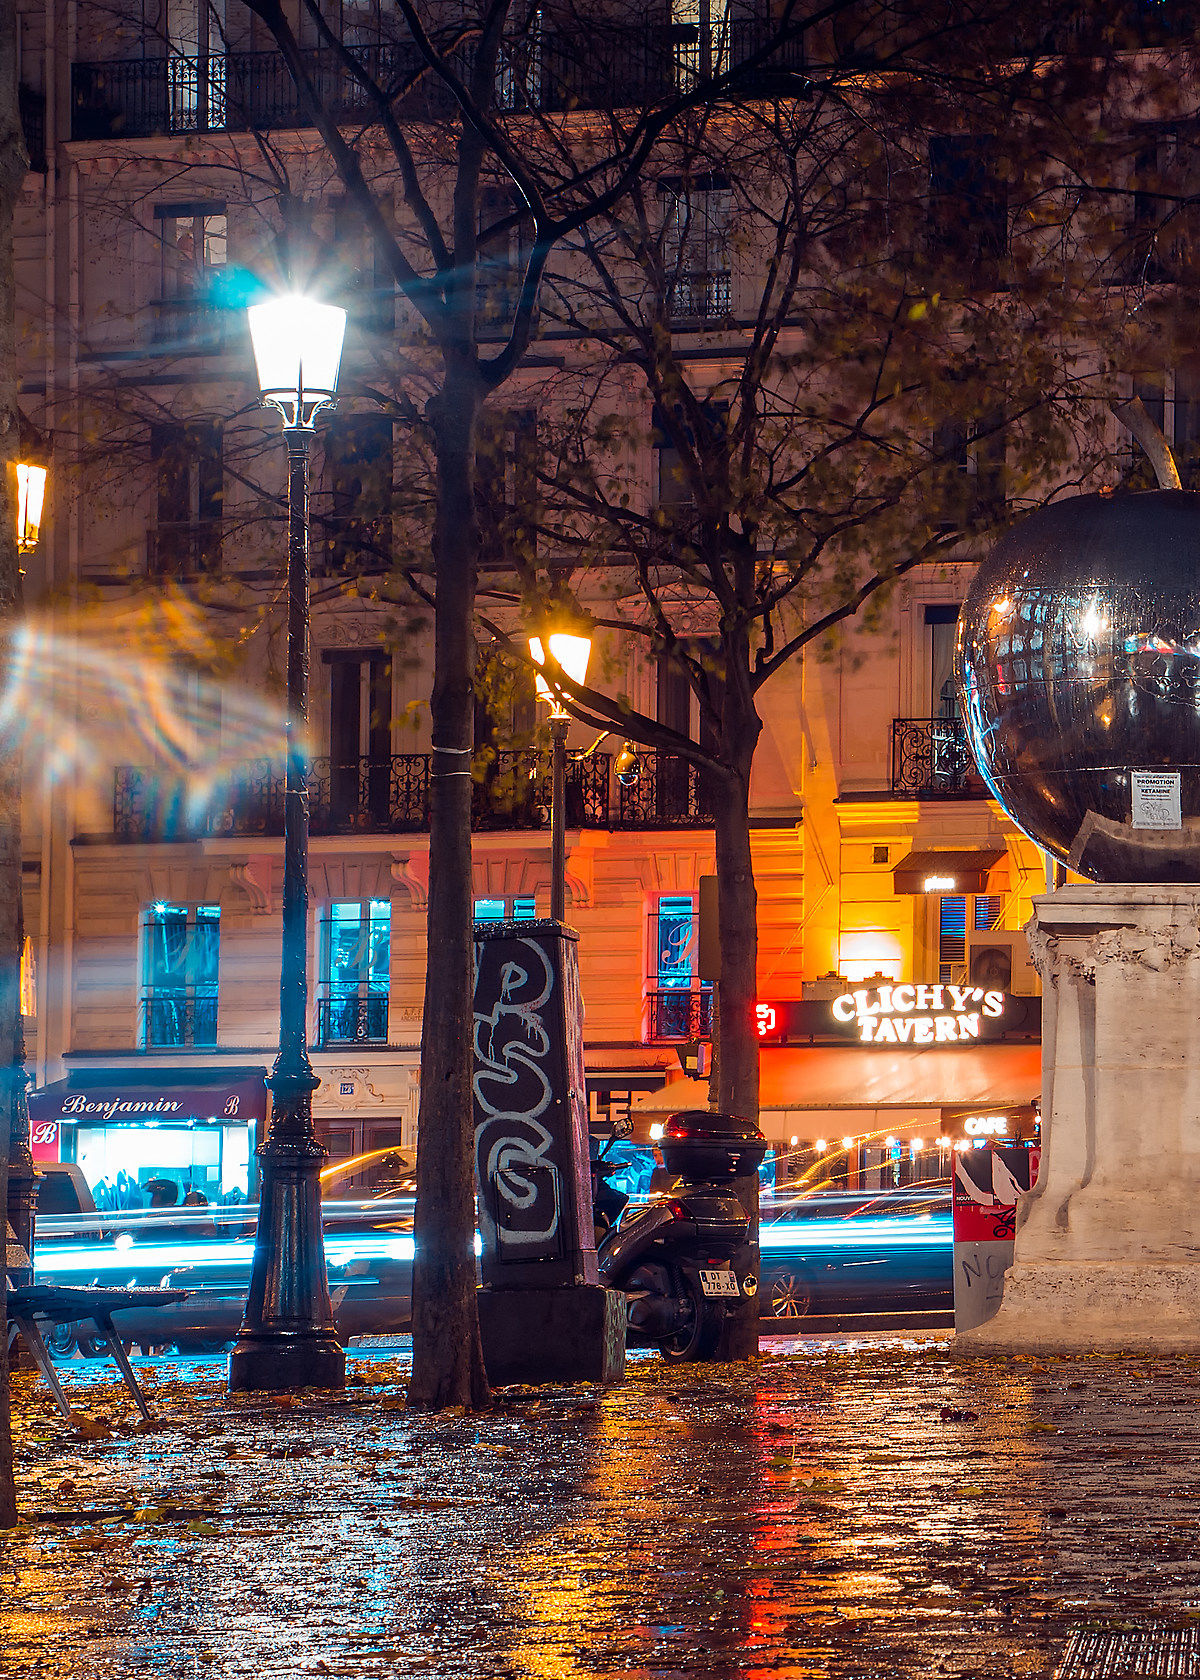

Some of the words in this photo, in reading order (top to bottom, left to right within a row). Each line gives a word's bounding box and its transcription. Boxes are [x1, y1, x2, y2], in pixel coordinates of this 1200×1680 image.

[832, 984, 1005, 1022] CLICHY'S
[857, 1012, 981, 1043] TAVERN
[61, 1094, 184, 1120] Benjamin
[223, 1094, 241, 1115] B
[32, 1121, 58, 1144] B
